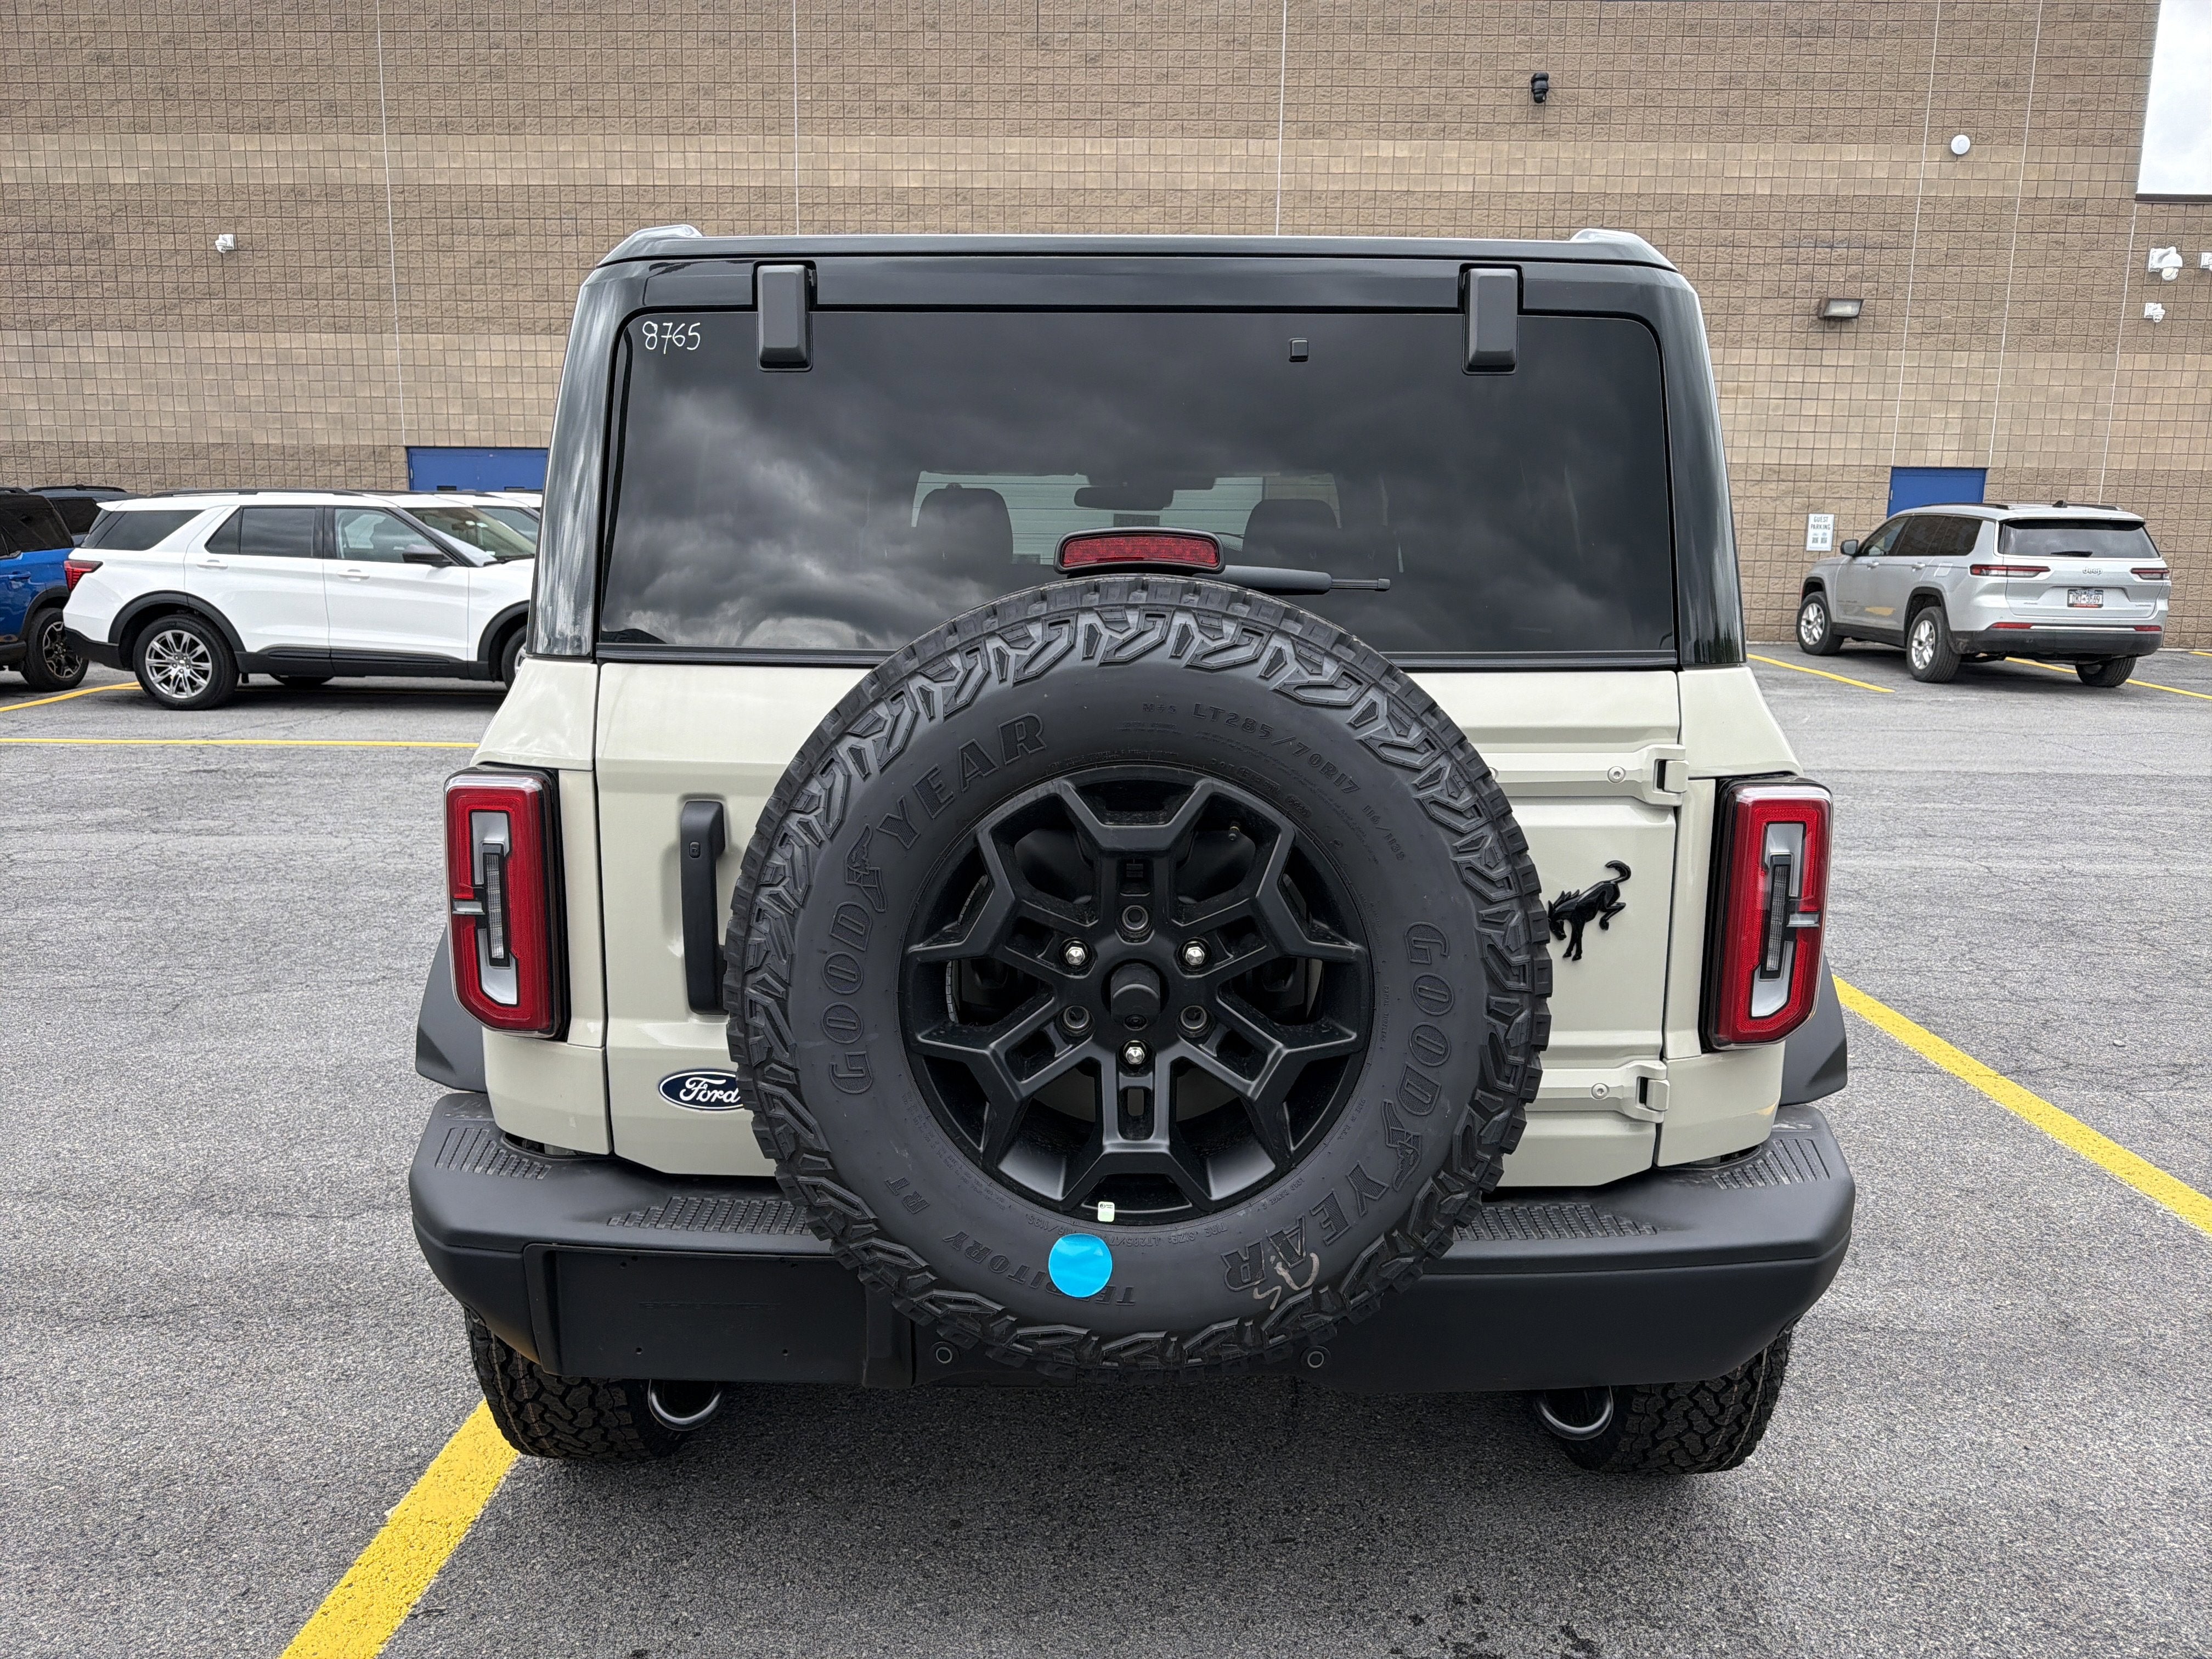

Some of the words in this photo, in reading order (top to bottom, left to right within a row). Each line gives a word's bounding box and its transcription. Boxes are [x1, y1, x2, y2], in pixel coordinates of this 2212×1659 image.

[642, 321, 701, 355] 8765
[2083, 566, 2103, 575] Jeep
[2086, 594, 2101, 603] 3569
[1142, 702, 1177, 714] M+S
[1192, 702, 1361, 793] LT285/70R17
[1362, 805, 1405, 861] 116/113S
[822, 713, 1047, 1094] GOODYEAR
[679, 1077, 741, 1103] Ford
[1221, 921, 1454, 1292] GOODYEAR
[884, 1176, 931, 1214] RT
[1204, 1222, 1228, 1237] TIRE
[942, 1231, 1136, 1306] TEITORY
